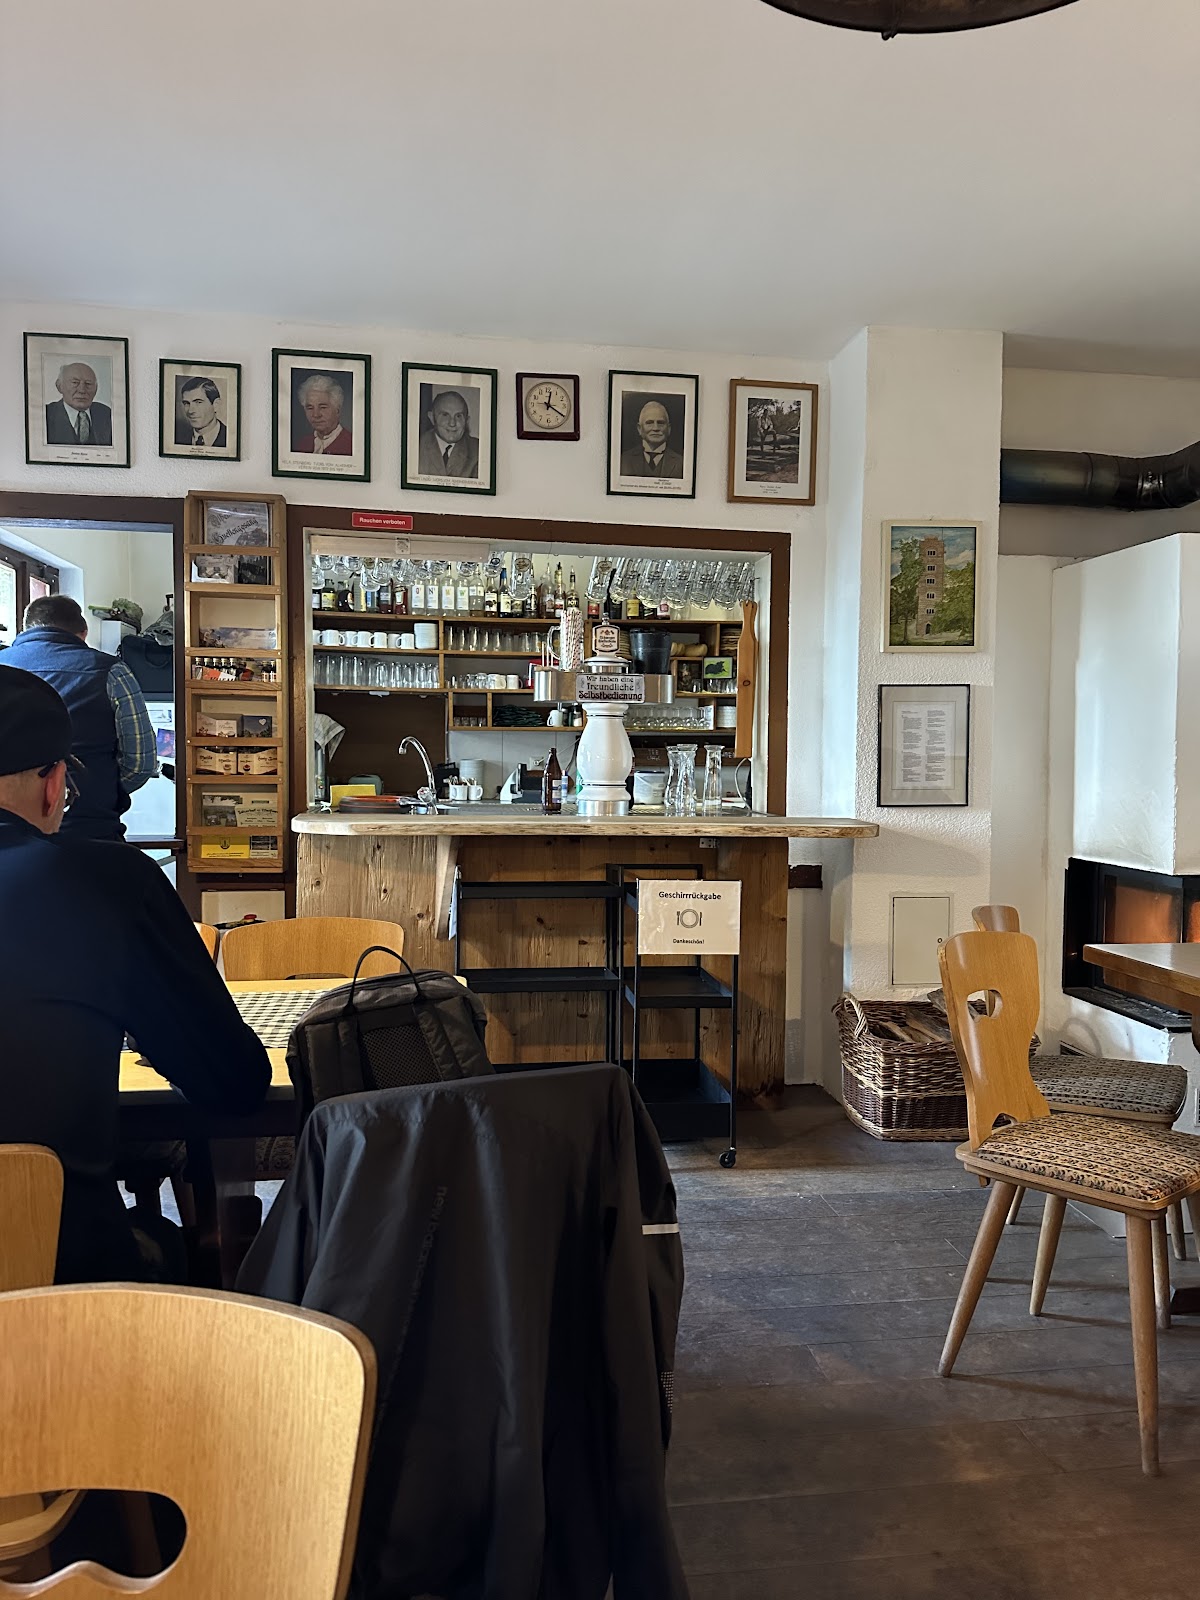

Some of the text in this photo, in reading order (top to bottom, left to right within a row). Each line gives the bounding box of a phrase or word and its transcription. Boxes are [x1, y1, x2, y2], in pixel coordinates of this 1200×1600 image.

[359, 516, 383, 524] Rauchen
[586, 682, 634, 691] freundliche
[578, 690, 643, 702] Selbstbedienung
[658, 891, 722, 901] Geschirrrückgabe
